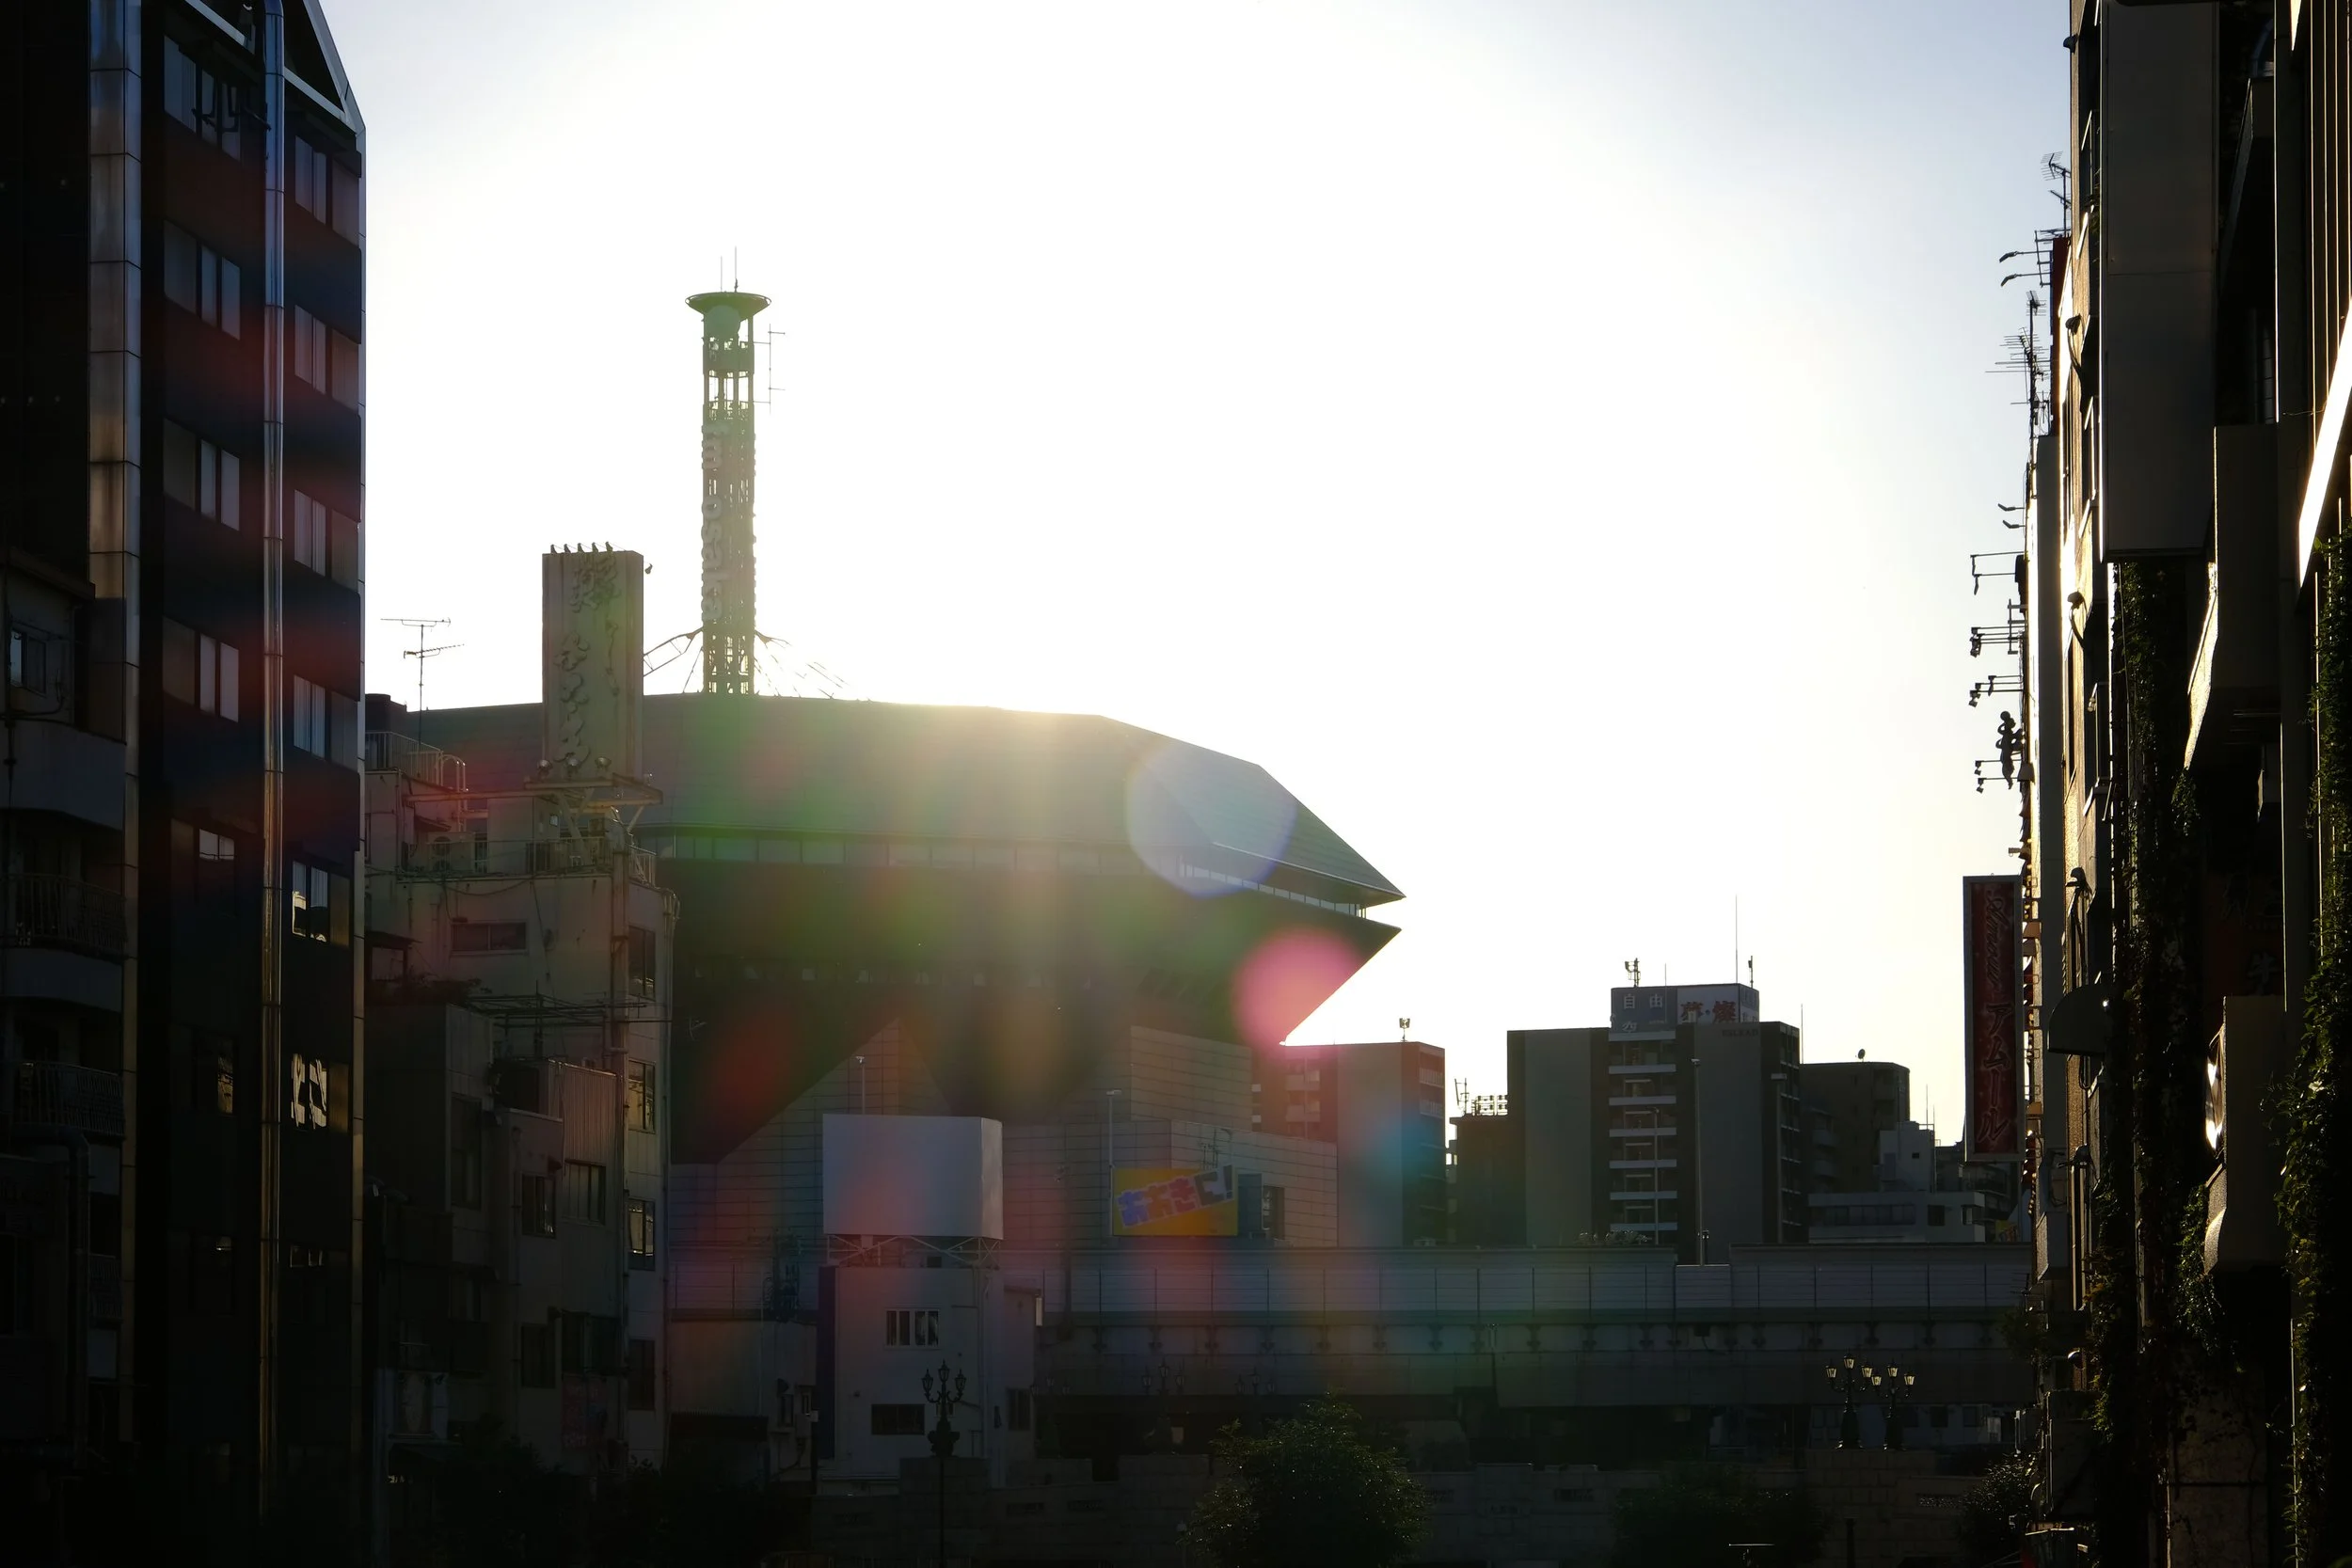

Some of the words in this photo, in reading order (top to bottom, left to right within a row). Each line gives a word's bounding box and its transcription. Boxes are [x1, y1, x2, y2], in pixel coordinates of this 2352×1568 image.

[1623, 992, 1663, 1009] 自由
[1977, 1002, 2013, 1143] アムール
